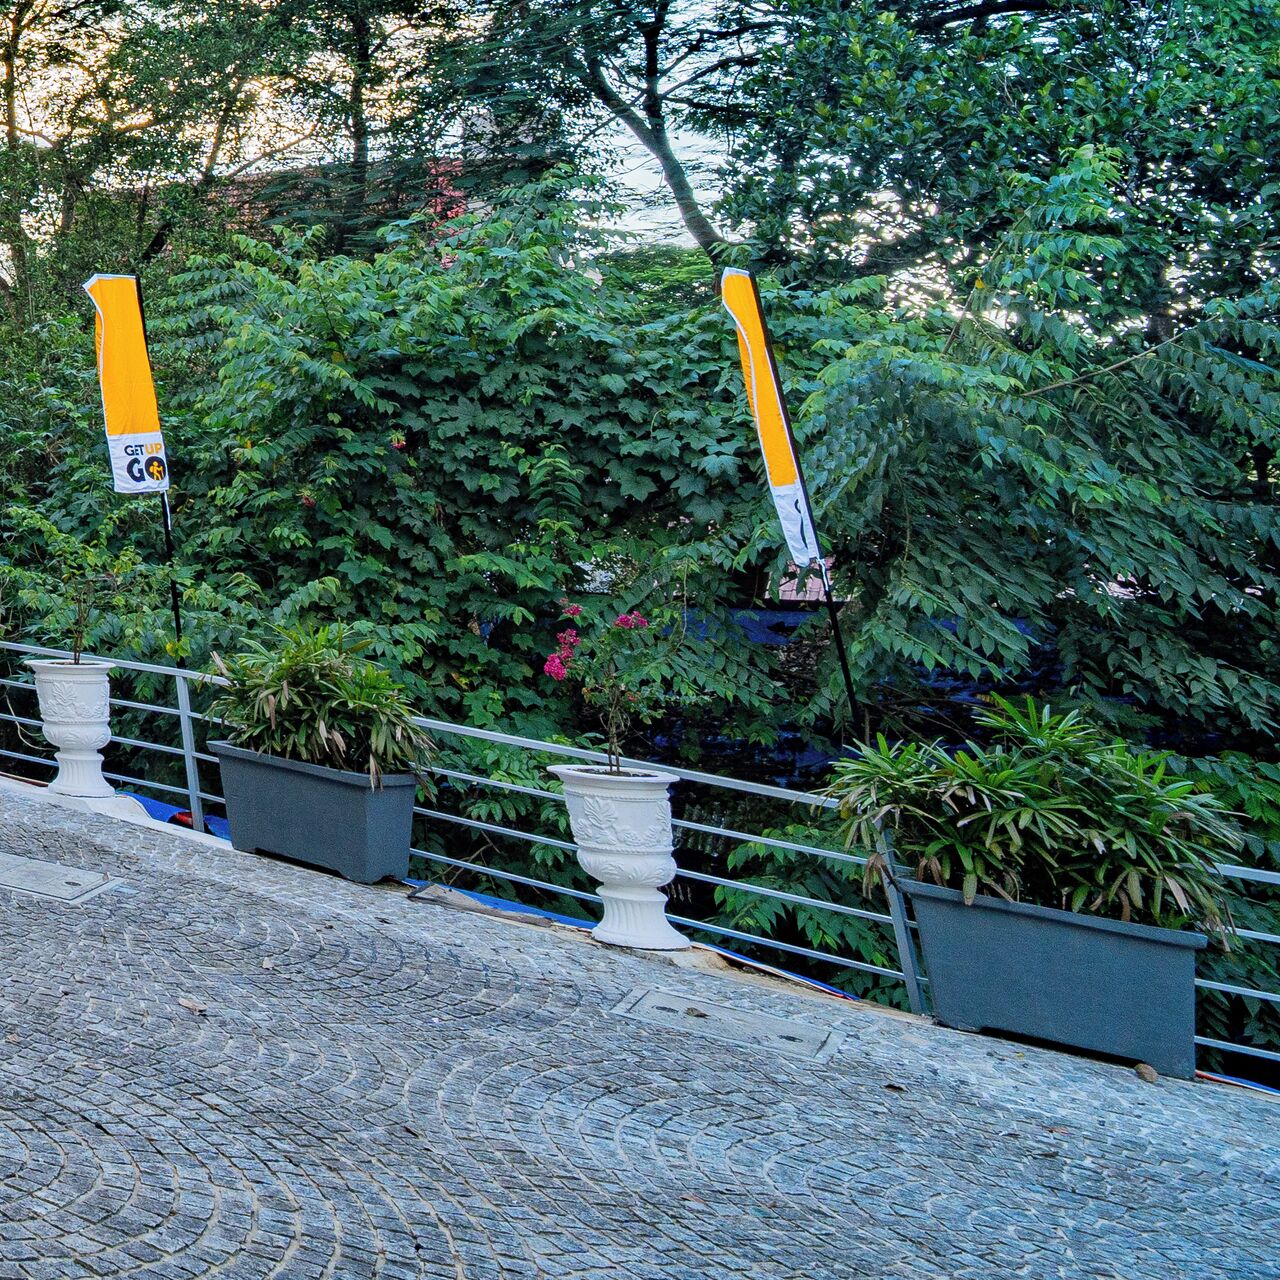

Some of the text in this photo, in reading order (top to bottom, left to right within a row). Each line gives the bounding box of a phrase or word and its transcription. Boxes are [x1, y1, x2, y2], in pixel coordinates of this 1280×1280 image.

[124, 442, 163, 456] GET UP
[126, 456, 167, 482] GO
